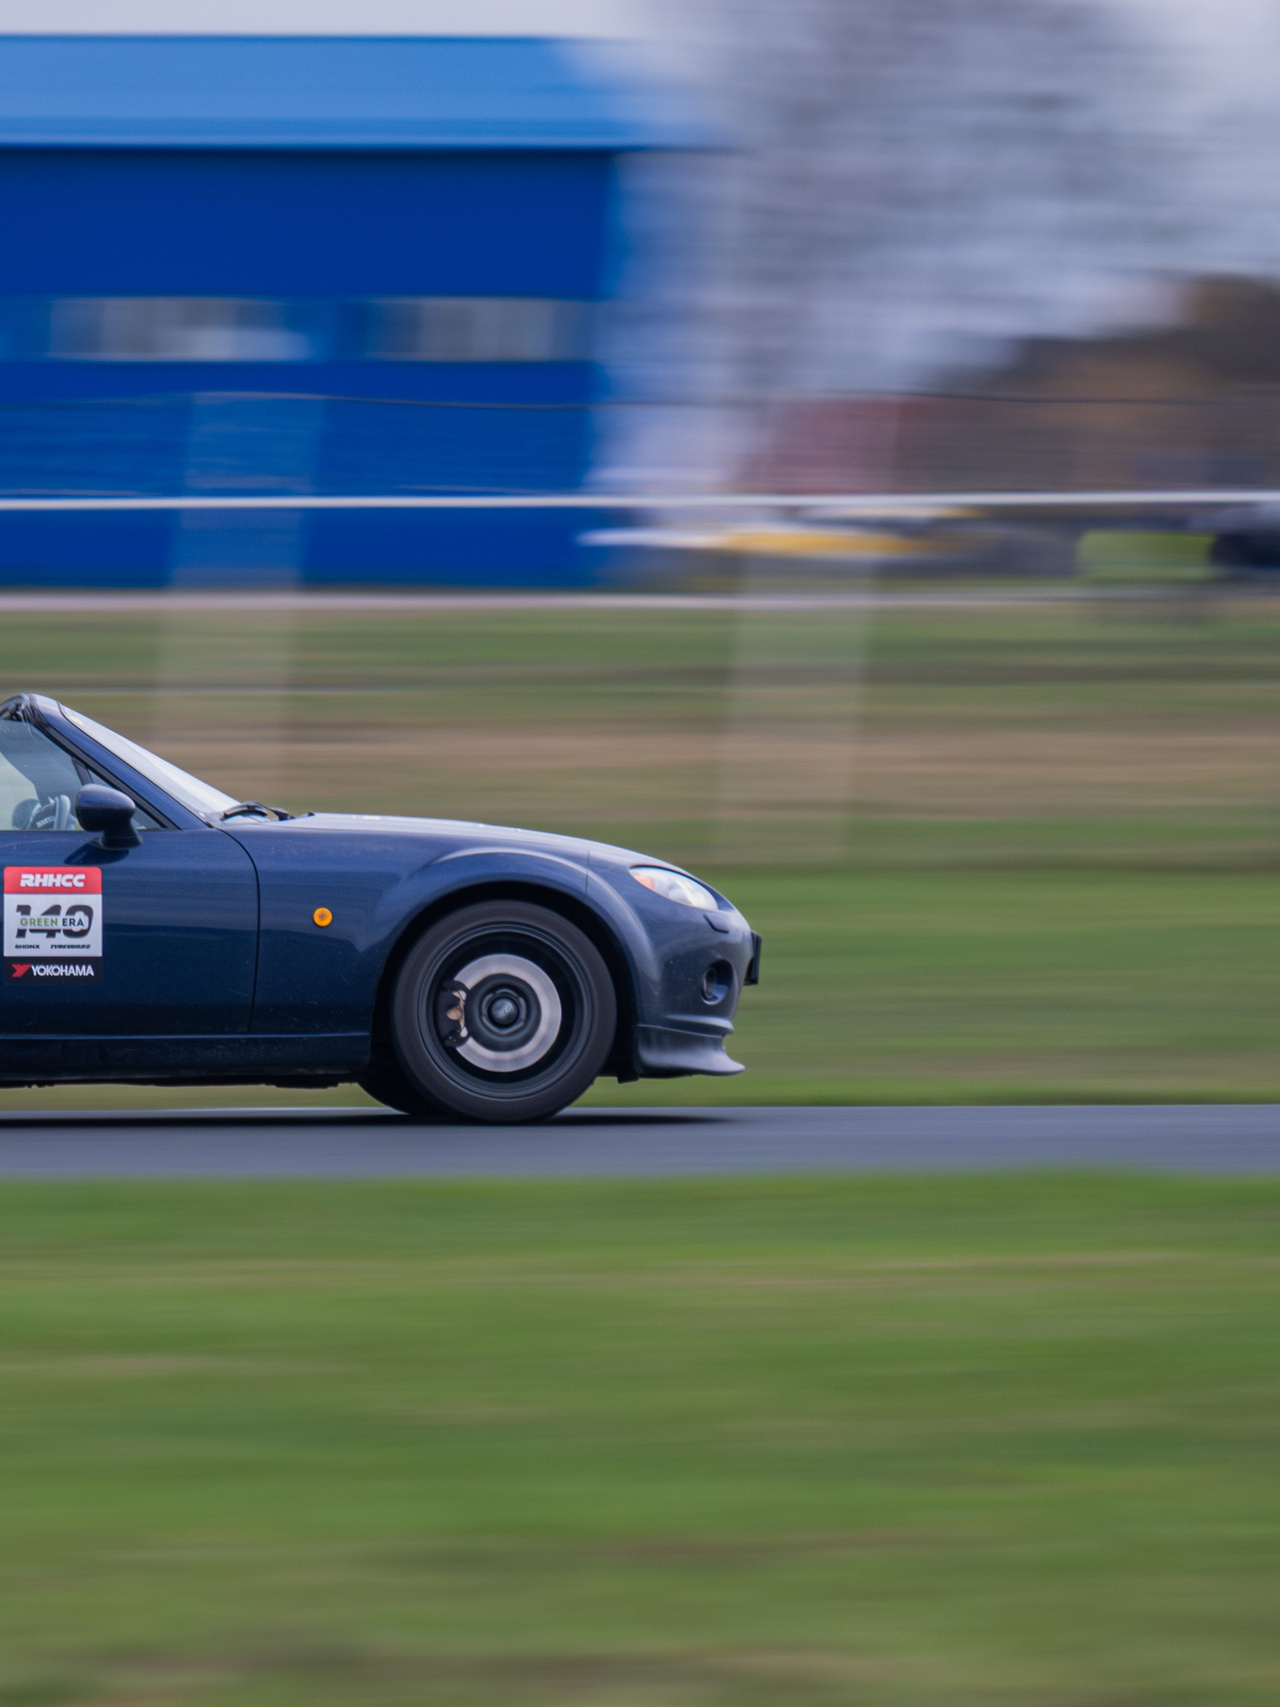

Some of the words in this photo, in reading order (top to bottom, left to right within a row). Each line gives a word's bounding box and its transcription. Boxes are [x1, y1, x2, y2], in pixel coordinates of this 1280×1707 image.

[20, 873, 86, 888] RHHCC
[15, 904, 94, 939] 140
[20, 917, 59, 927] GREEN
[62, 917, 85, 927] ERA
[31, 964, 95, 977] YOKOHAMA
